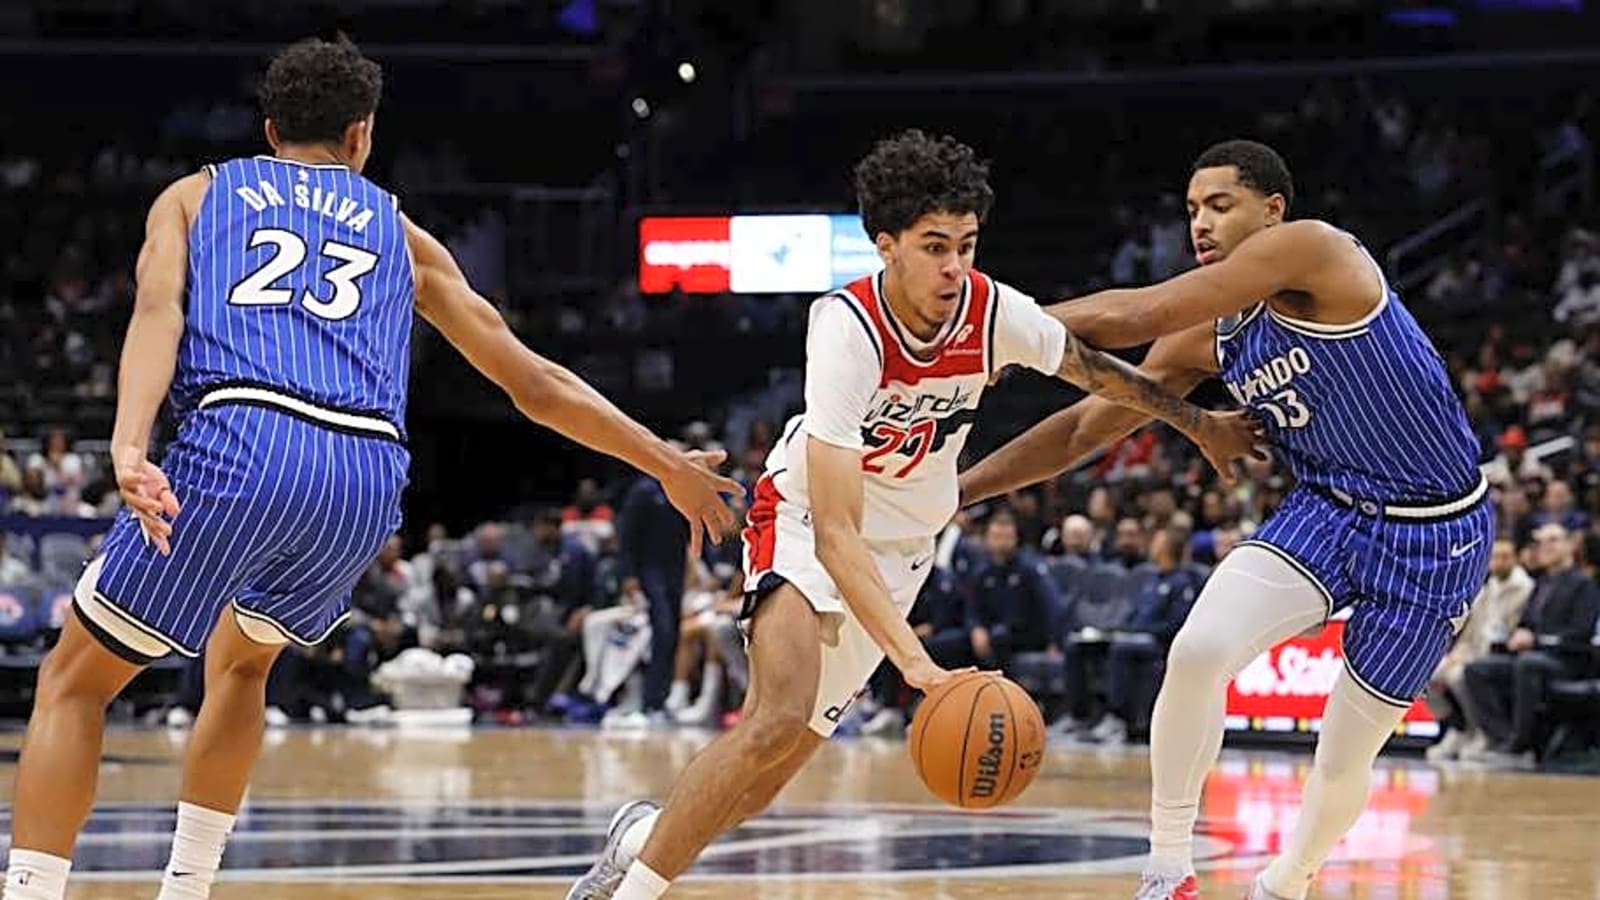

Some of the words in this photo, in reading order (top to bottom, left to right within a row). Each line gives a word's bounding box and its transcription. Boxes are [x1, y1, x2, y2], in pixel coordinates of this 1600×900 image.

[236, 180, 285, 211] DA
[294, 184, 374, 232] SILVA
[227, 228, 380, 321] 23
[859, 419, 937, 479] 27
[969, 713, 1004, 797] Wilson
